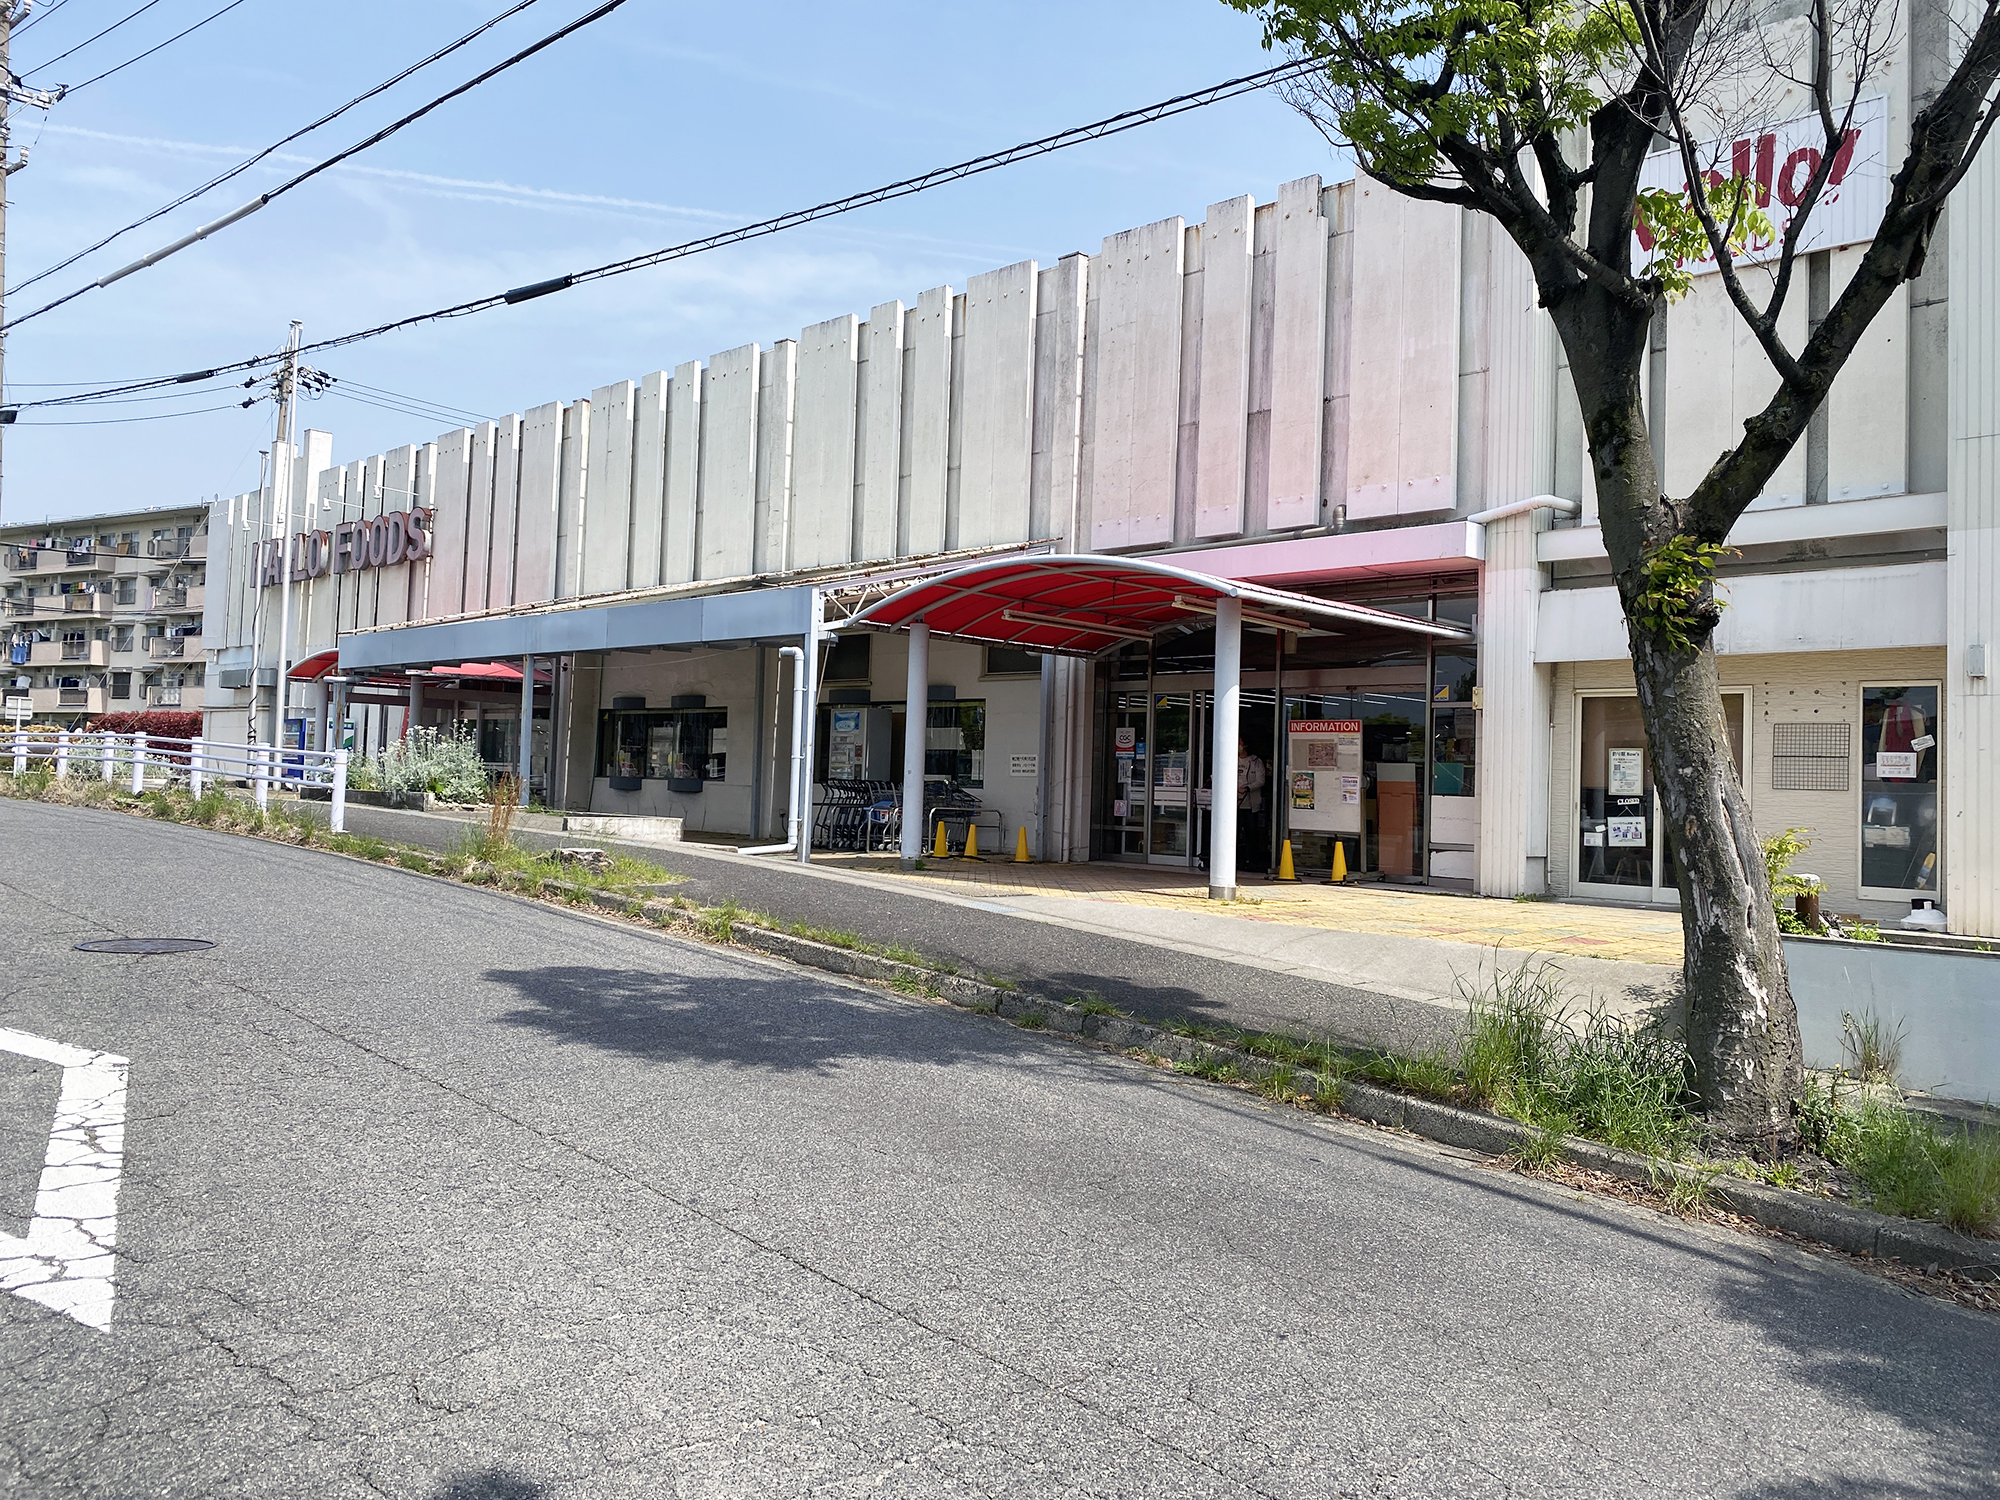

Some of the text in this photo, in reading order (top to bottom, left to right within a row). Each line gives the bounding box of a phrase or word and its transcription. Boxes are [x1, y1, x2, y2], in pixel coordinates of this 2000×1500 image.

[250, 506, 432, 588] HALO FOODS
[1291, 721, 1358, 732] INFORMATION
